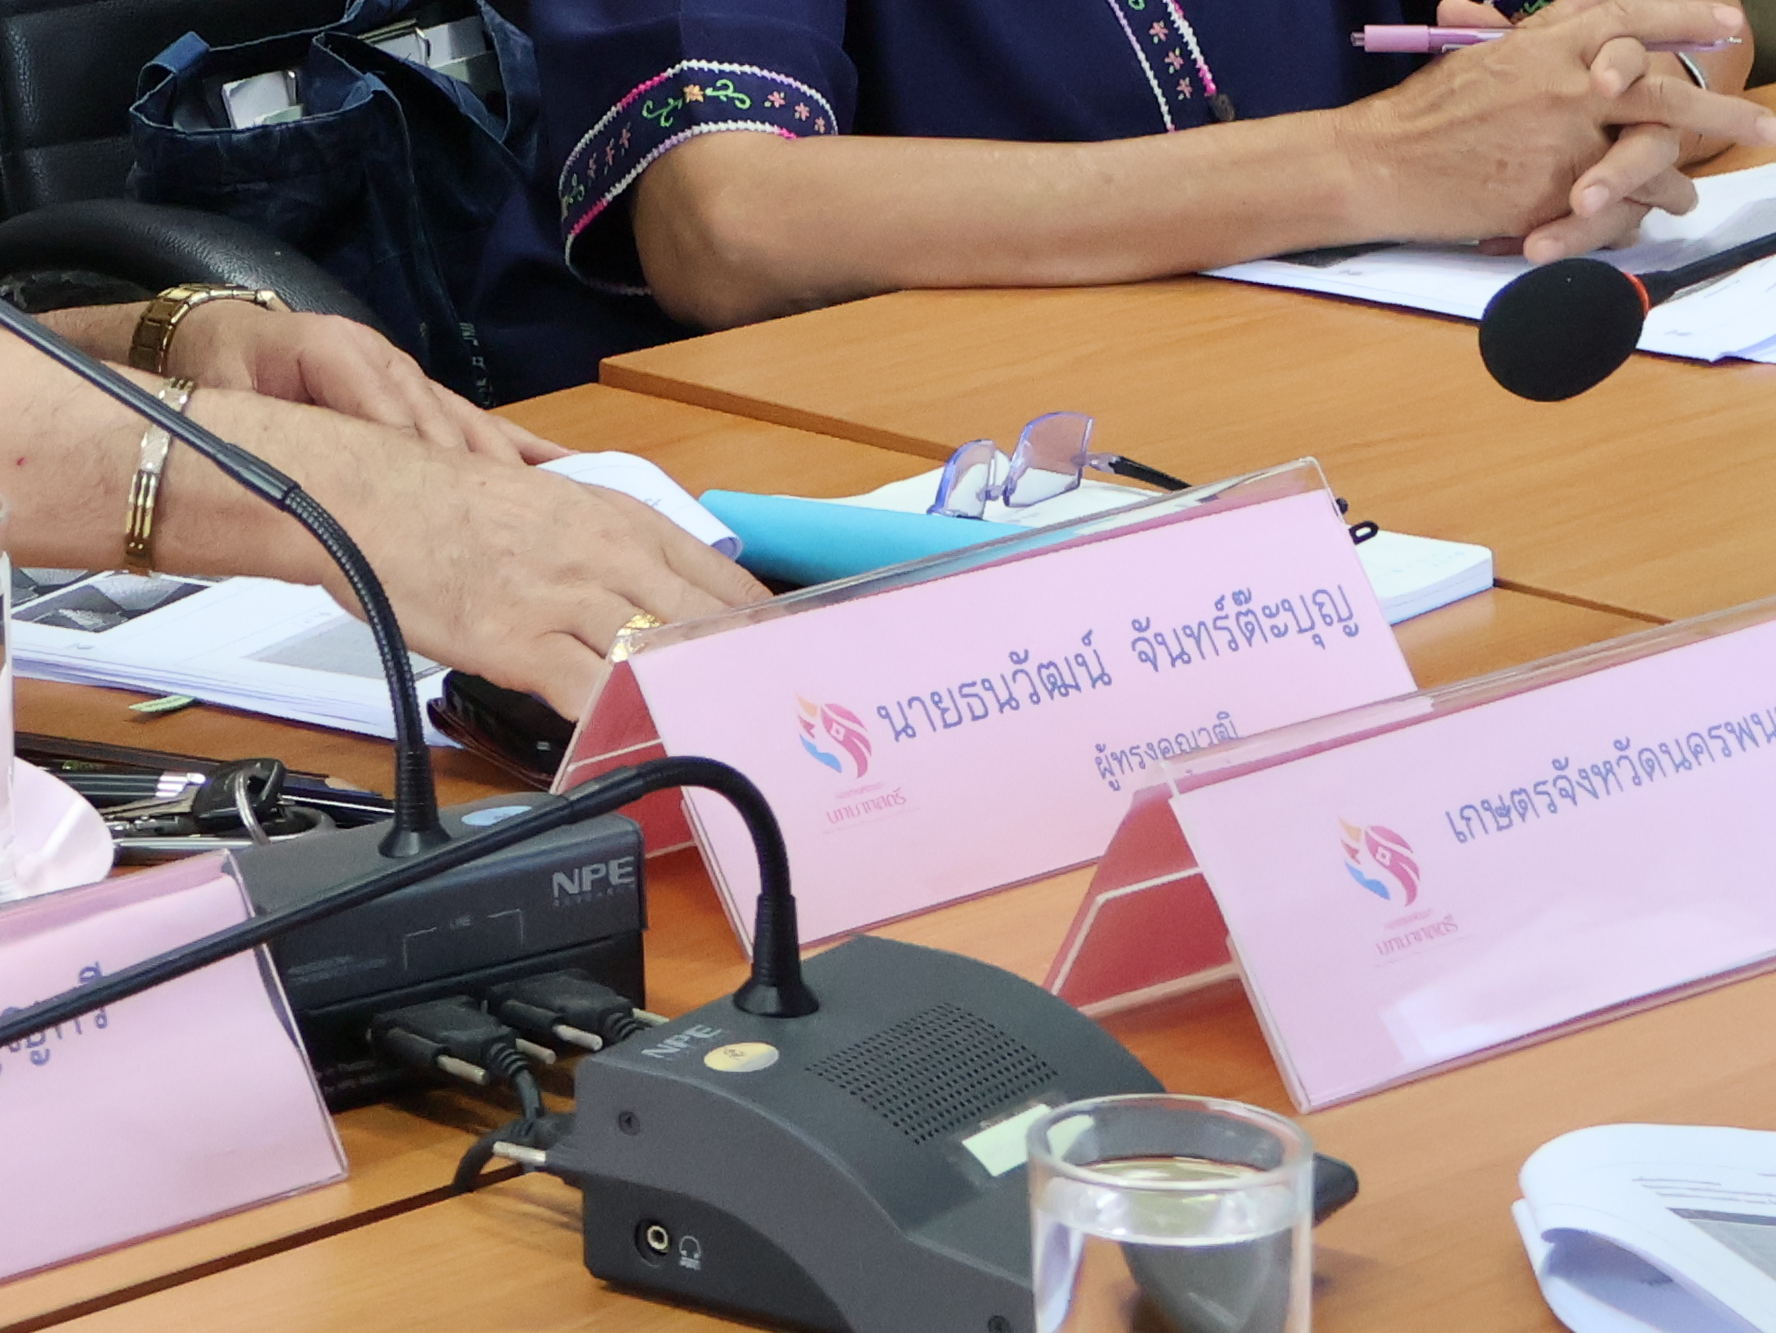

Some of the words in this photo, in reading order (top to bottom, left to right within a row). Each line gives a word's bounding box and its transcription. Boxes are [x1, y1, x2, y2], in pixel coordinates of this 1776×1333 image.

[876, 629, 1113, 743] นายธนวัฒน์
[1094, 710, 1239, 792] ผู้ทรงคณวฒิ
[1445, 705, 1776, 845] เกษตรจังหวัดนครพน
[552, 856, 635, 899] NPE
[641, 1024, 723, 1059] NPE
